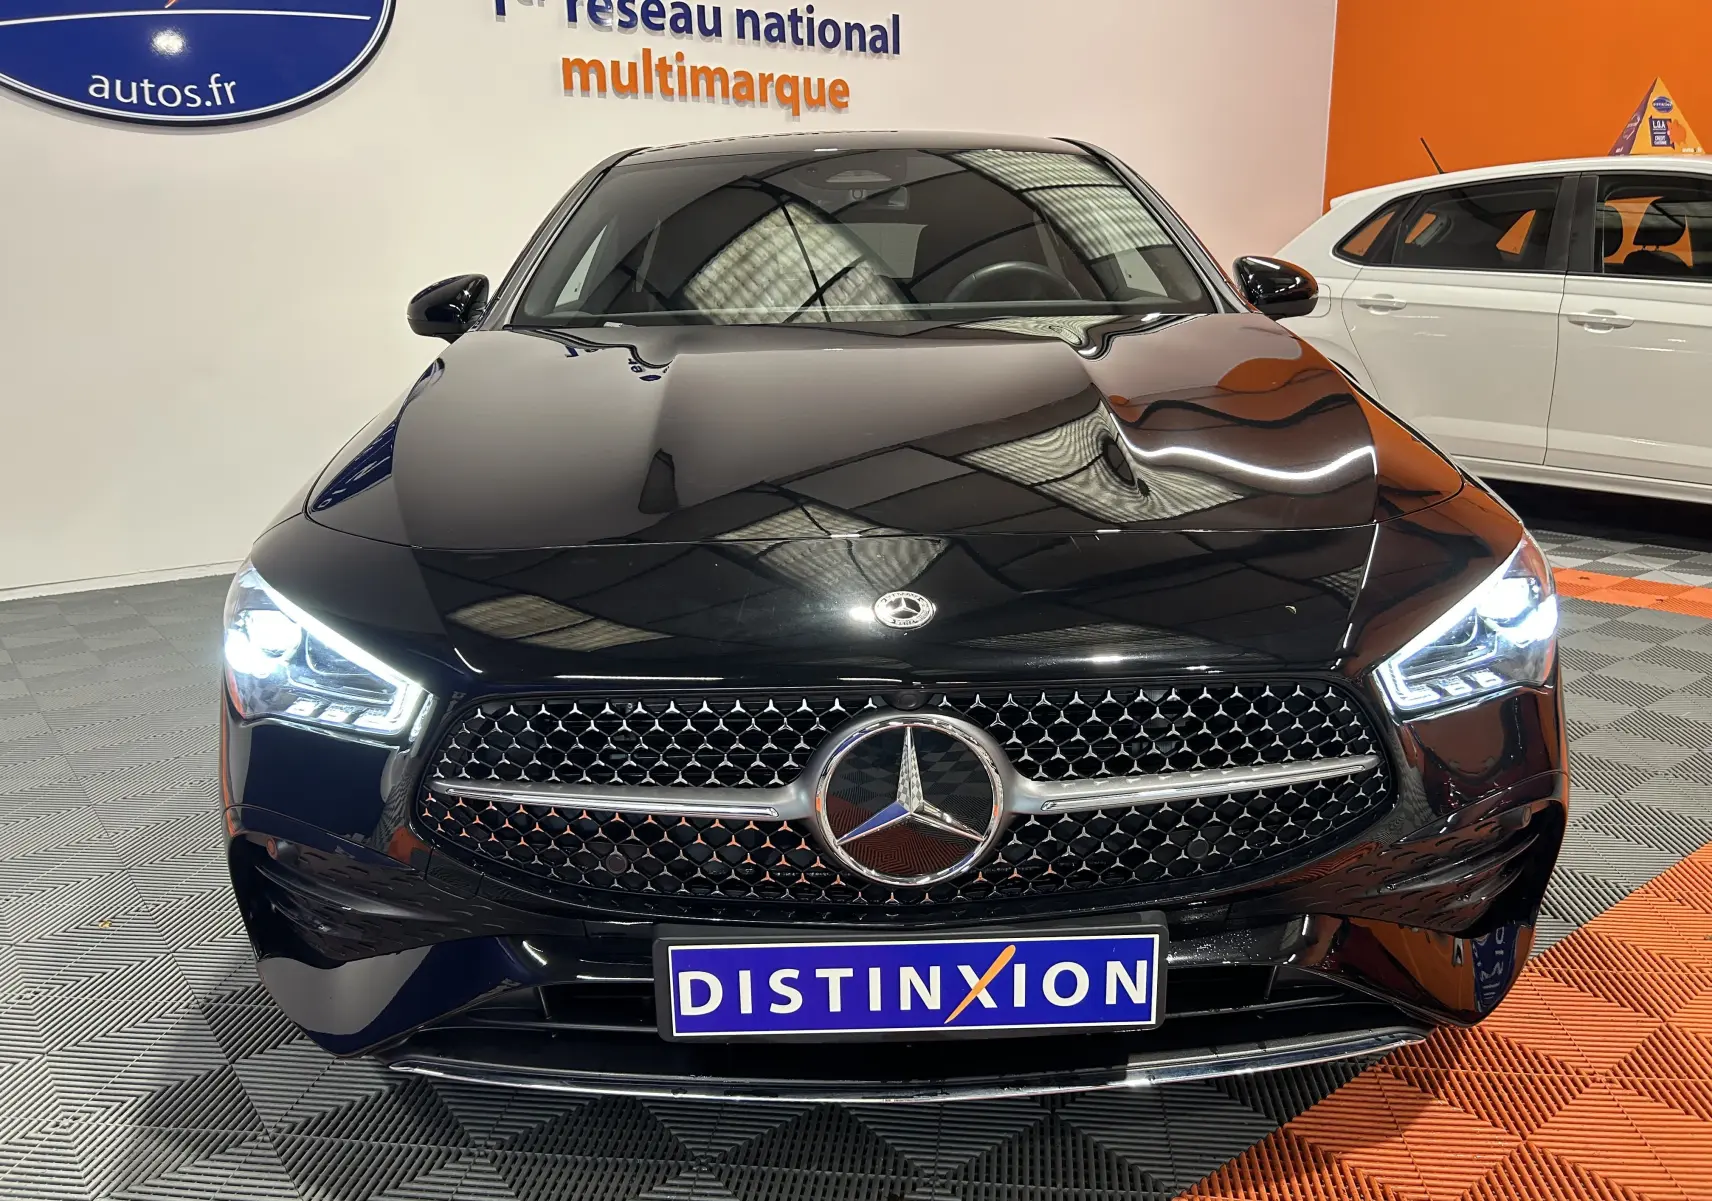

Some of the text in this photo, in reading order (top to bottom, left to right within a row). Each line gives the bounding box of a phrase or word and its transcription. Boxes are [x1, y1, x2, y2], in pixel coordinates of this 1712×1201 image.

[735, 4, 900, 55] national
[88, 73, 236, 108] autos.fr
[562, 48, 850, 117] multimarque
[678, 945, 1148, 1024] DISTINXION
